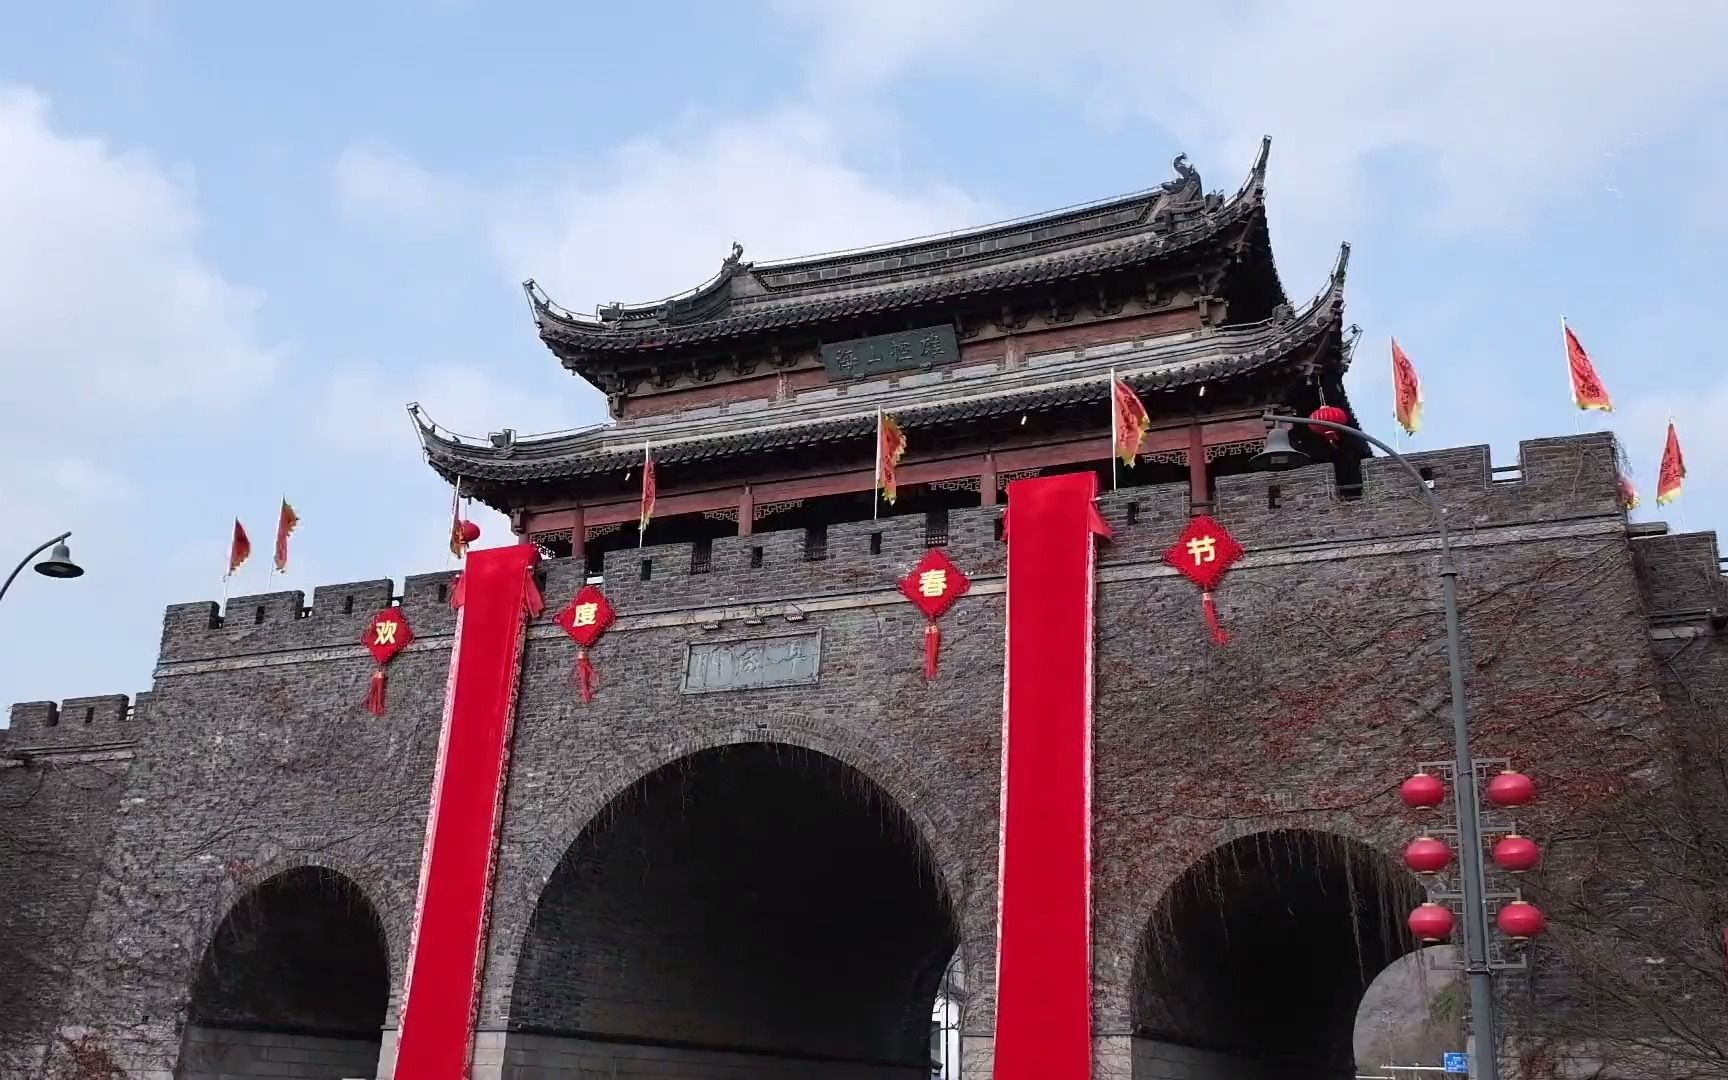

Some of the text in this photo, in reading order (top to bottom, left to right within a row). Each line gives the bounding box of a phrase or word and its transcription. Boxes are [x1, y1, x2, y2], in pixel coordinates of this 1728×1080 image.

[373, 535, 1217, 646] 欢 度 春 节
